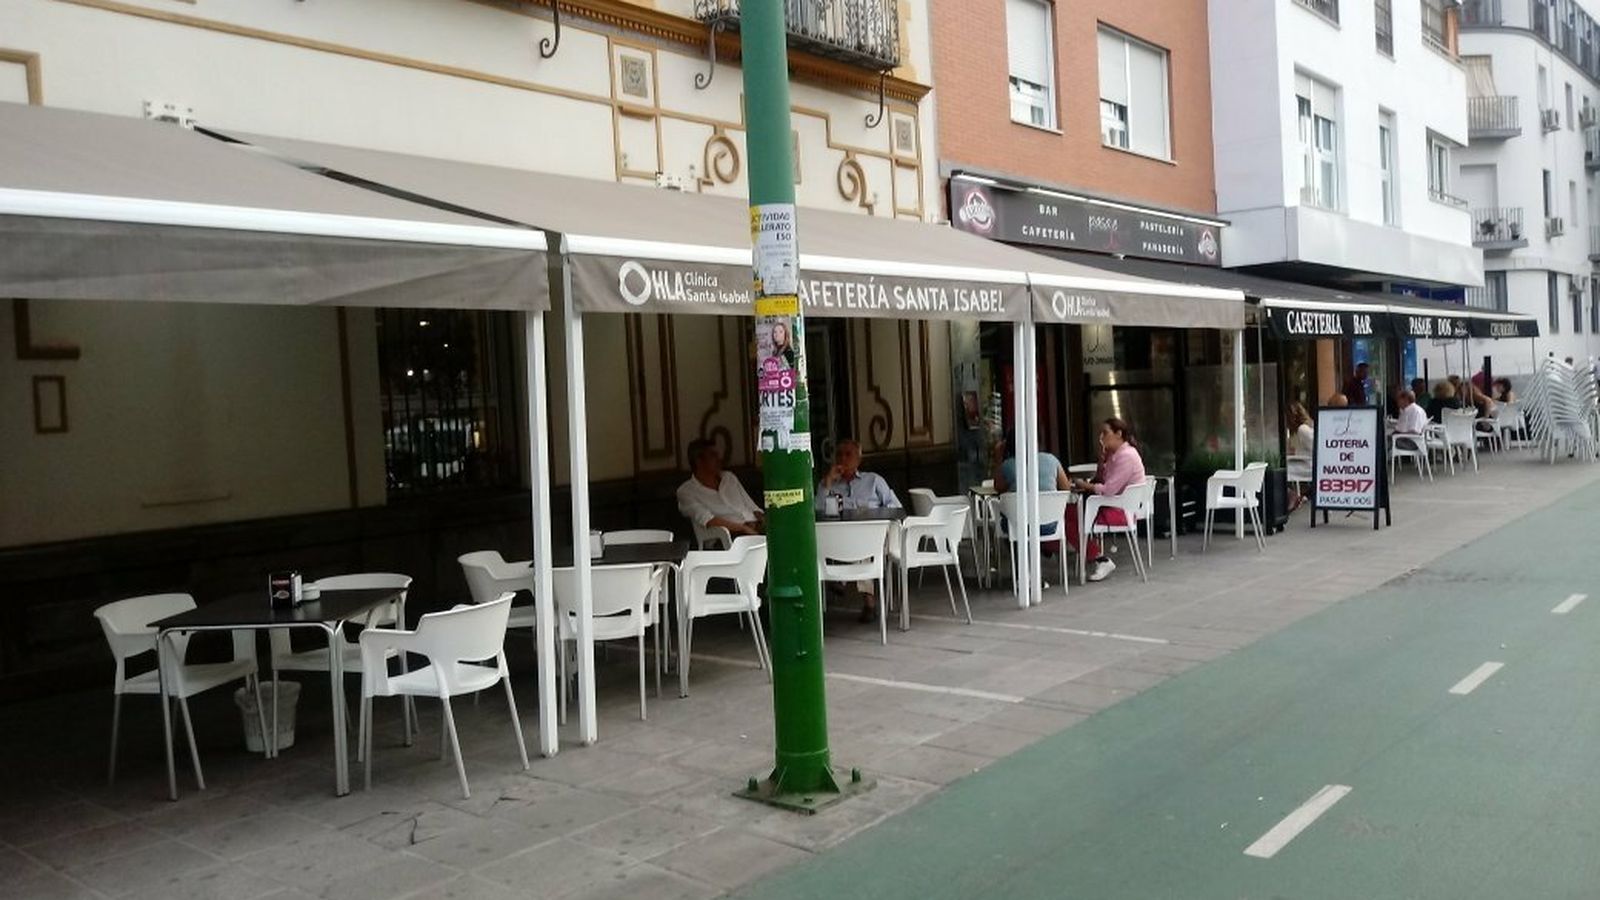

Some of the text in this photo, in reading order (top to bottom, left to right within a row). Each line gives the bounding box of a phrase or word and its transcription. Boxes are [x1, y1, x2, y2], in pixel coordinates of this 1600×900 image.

[1039, 203, 1058, 217] BAR
[1022, 225, 1076, 241] CAFETERÍA
[684, 271, 718, 287] Clínica
[685, 288, 751, 304] Santa Isabel
[799, 276, 1006, 313] AFETERÍA SANTA ISABEL
[1353, 314, 1373, 335] BAR
[1437, 318, 1452, 336] DOS
[1325, 439, 1369, 449] LOTERIA
[1339, 452, 1355, 462] DE
[1322, 465, 1371, 475] NAVIDAD
[1319, 479, 1374, 493] 83917
[1319, 495, 1372, 505] PASAJE DOS
